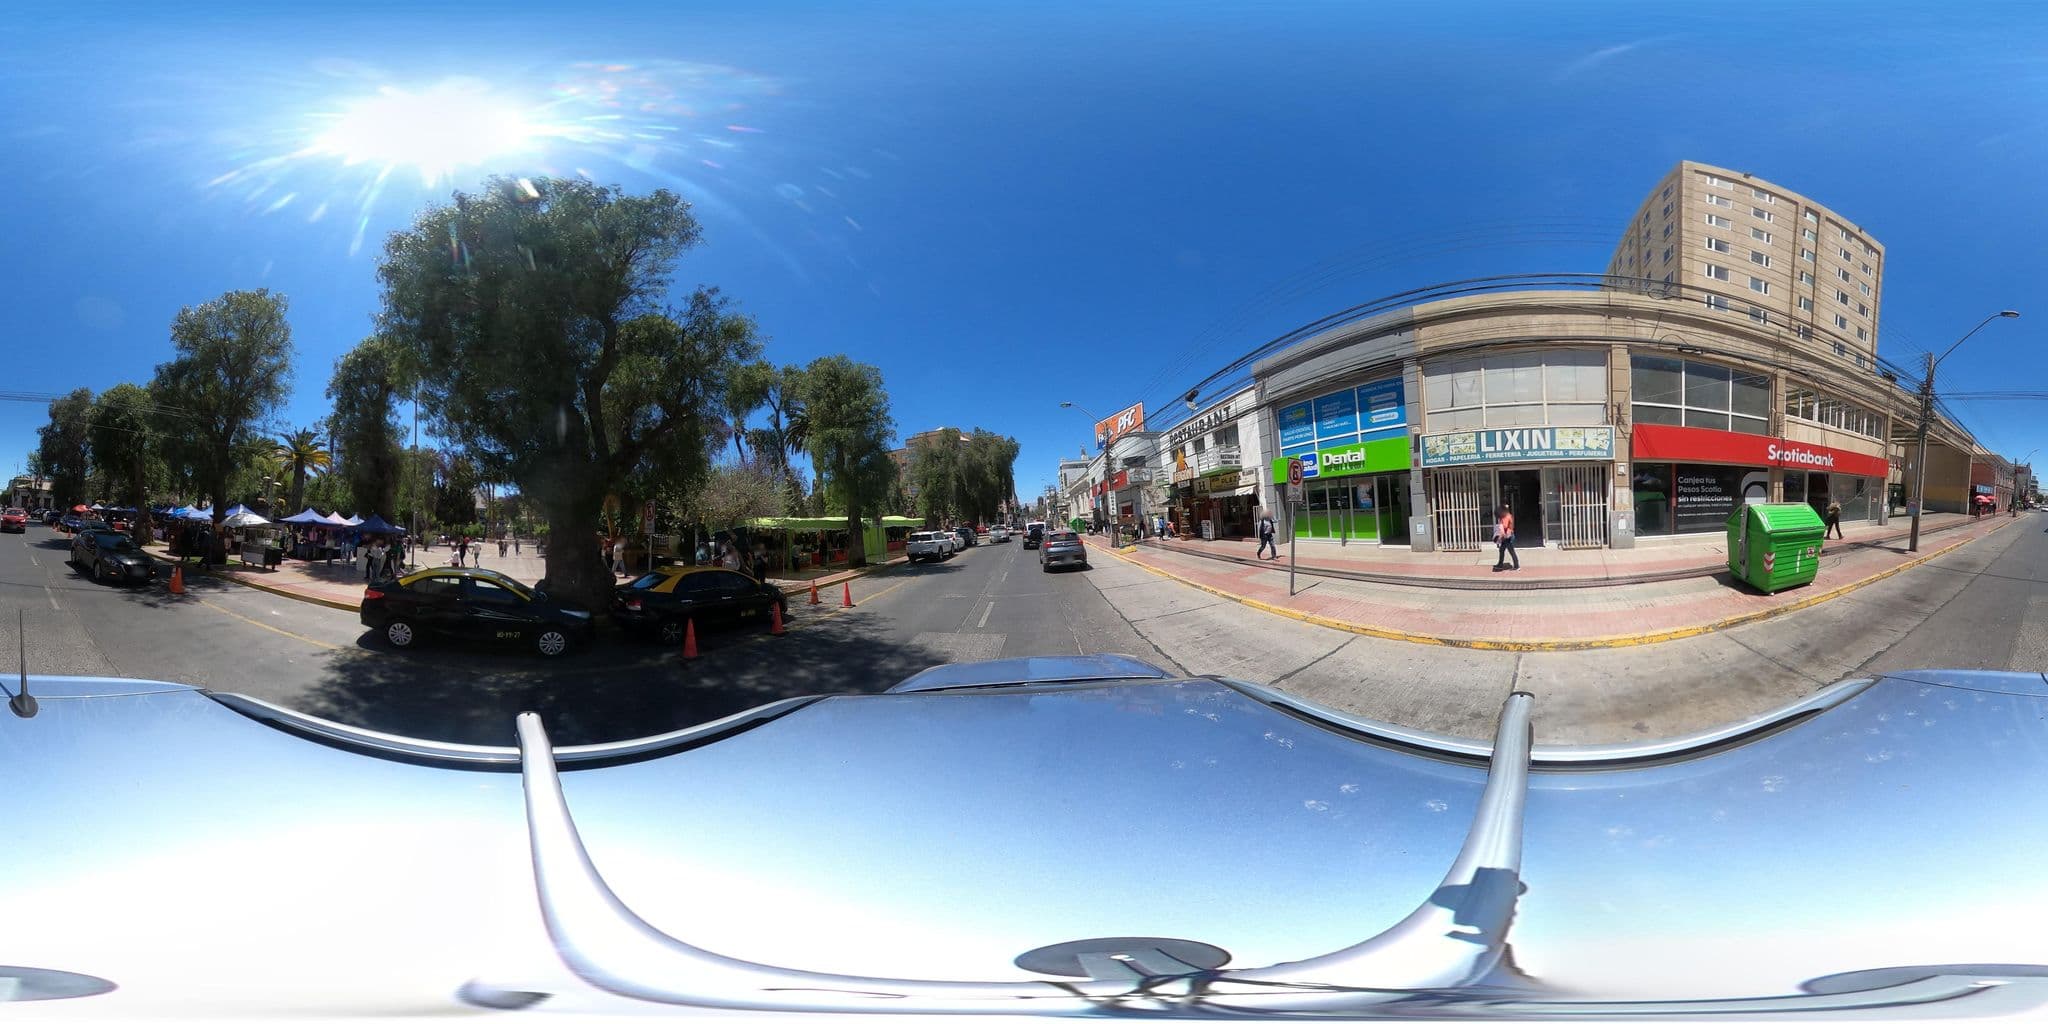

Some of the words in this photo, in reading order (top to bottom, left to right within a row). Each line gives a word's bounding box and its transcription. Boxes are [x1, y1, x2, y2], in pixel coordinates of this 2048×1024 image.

[1117, 408, 1136, 434] PFC
[1170, 405, 1232, 446] RESTAURANT
[1481, 429, 1551, 452] LIXIN
[1322, 448, 1365, 466] Dental
[1486, 450, 1521, 458] FERRETERIA
[1768, 444, 1833, 467] Scotiabank
[1678, 476, 1705, 485] Canjea
[1678, 485, 1700, 493] Pesos
[1689, 494, 1733, 502] restricciones
